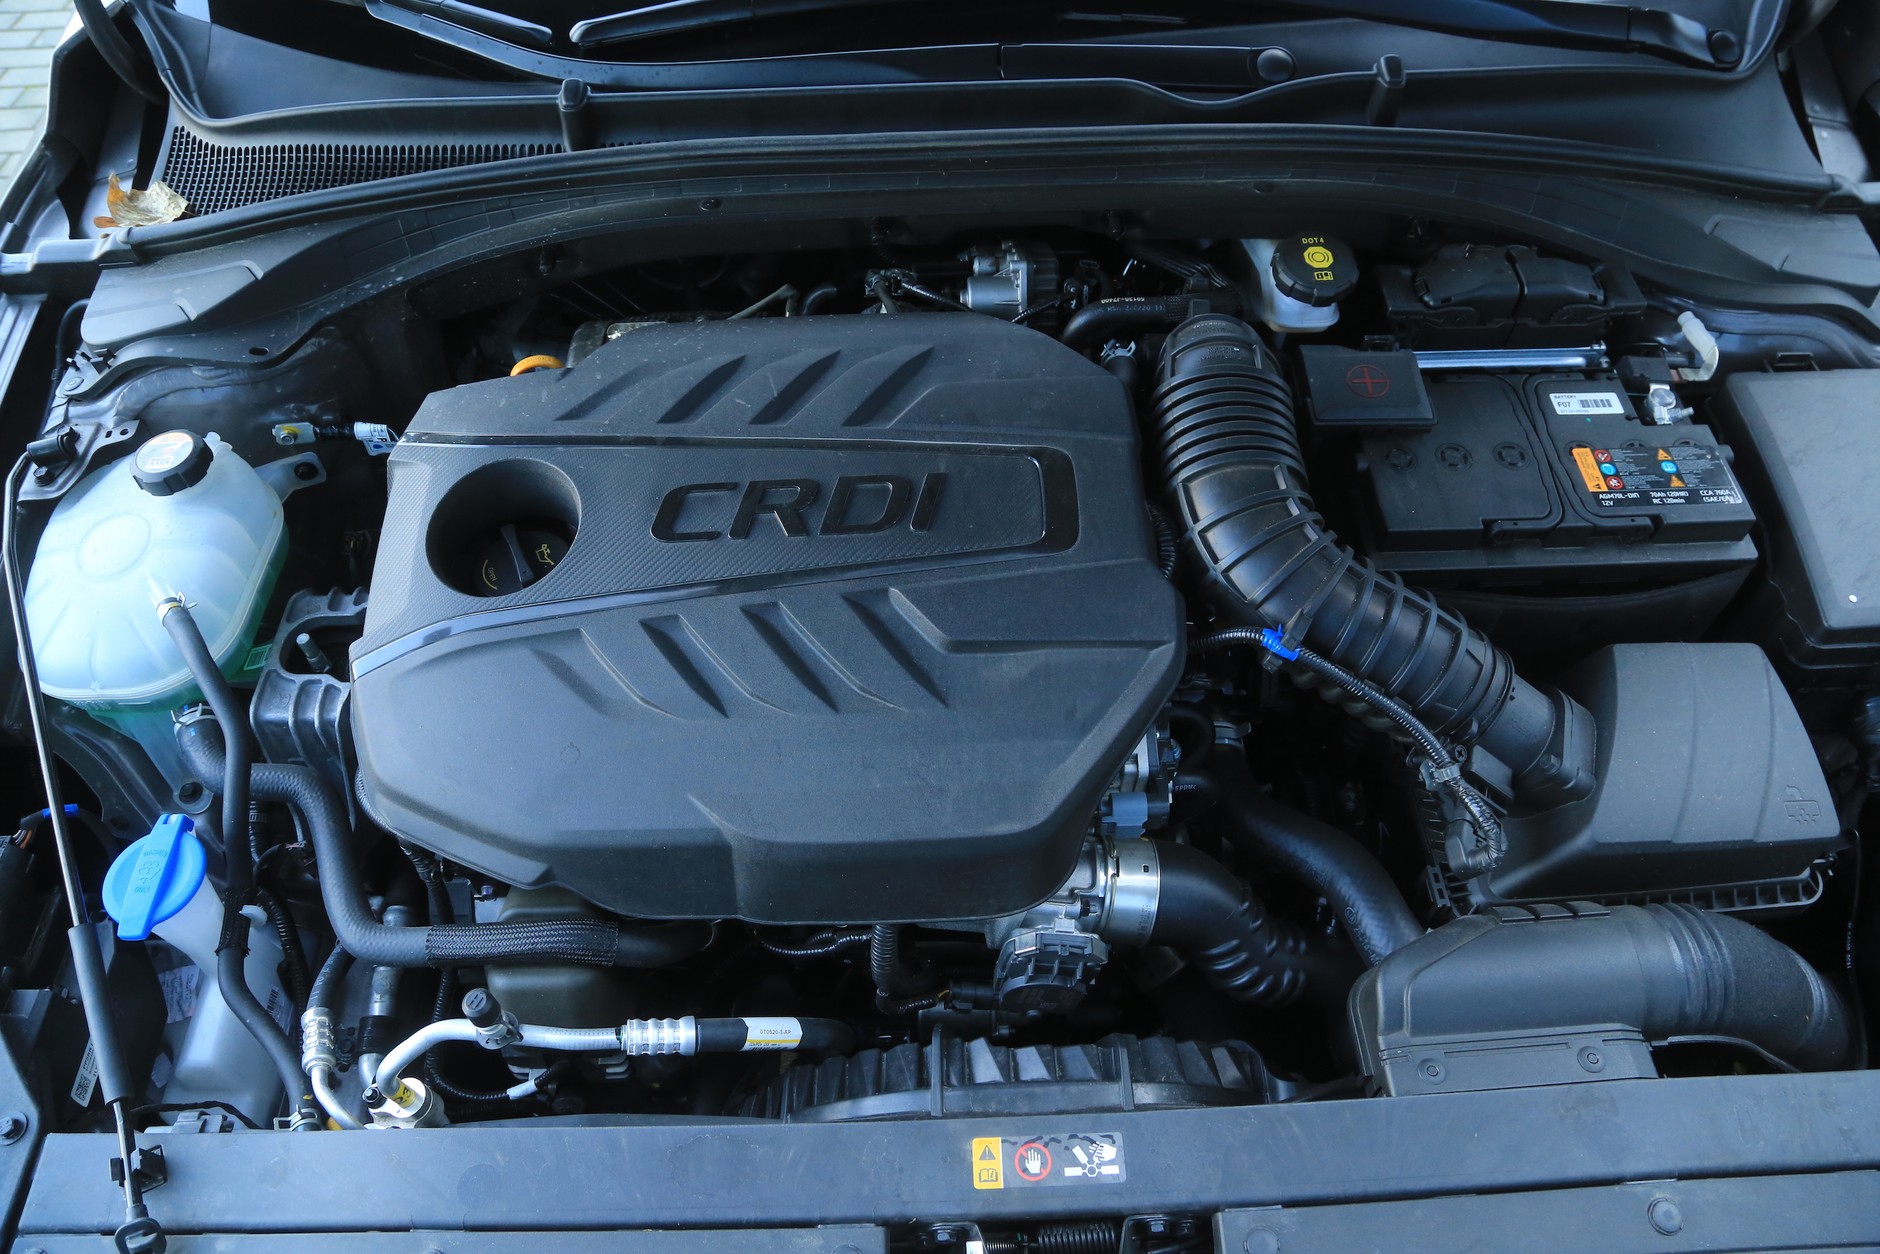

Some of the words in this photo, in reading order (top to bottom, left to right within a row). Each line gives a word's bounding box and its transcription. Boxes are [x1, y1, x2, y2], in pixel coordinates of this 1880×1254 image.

[1649, 490, 1667, 498] 70Ah
[650, 472, 947, 543] CRDI
[134, 886, 151, 894] ONLY
